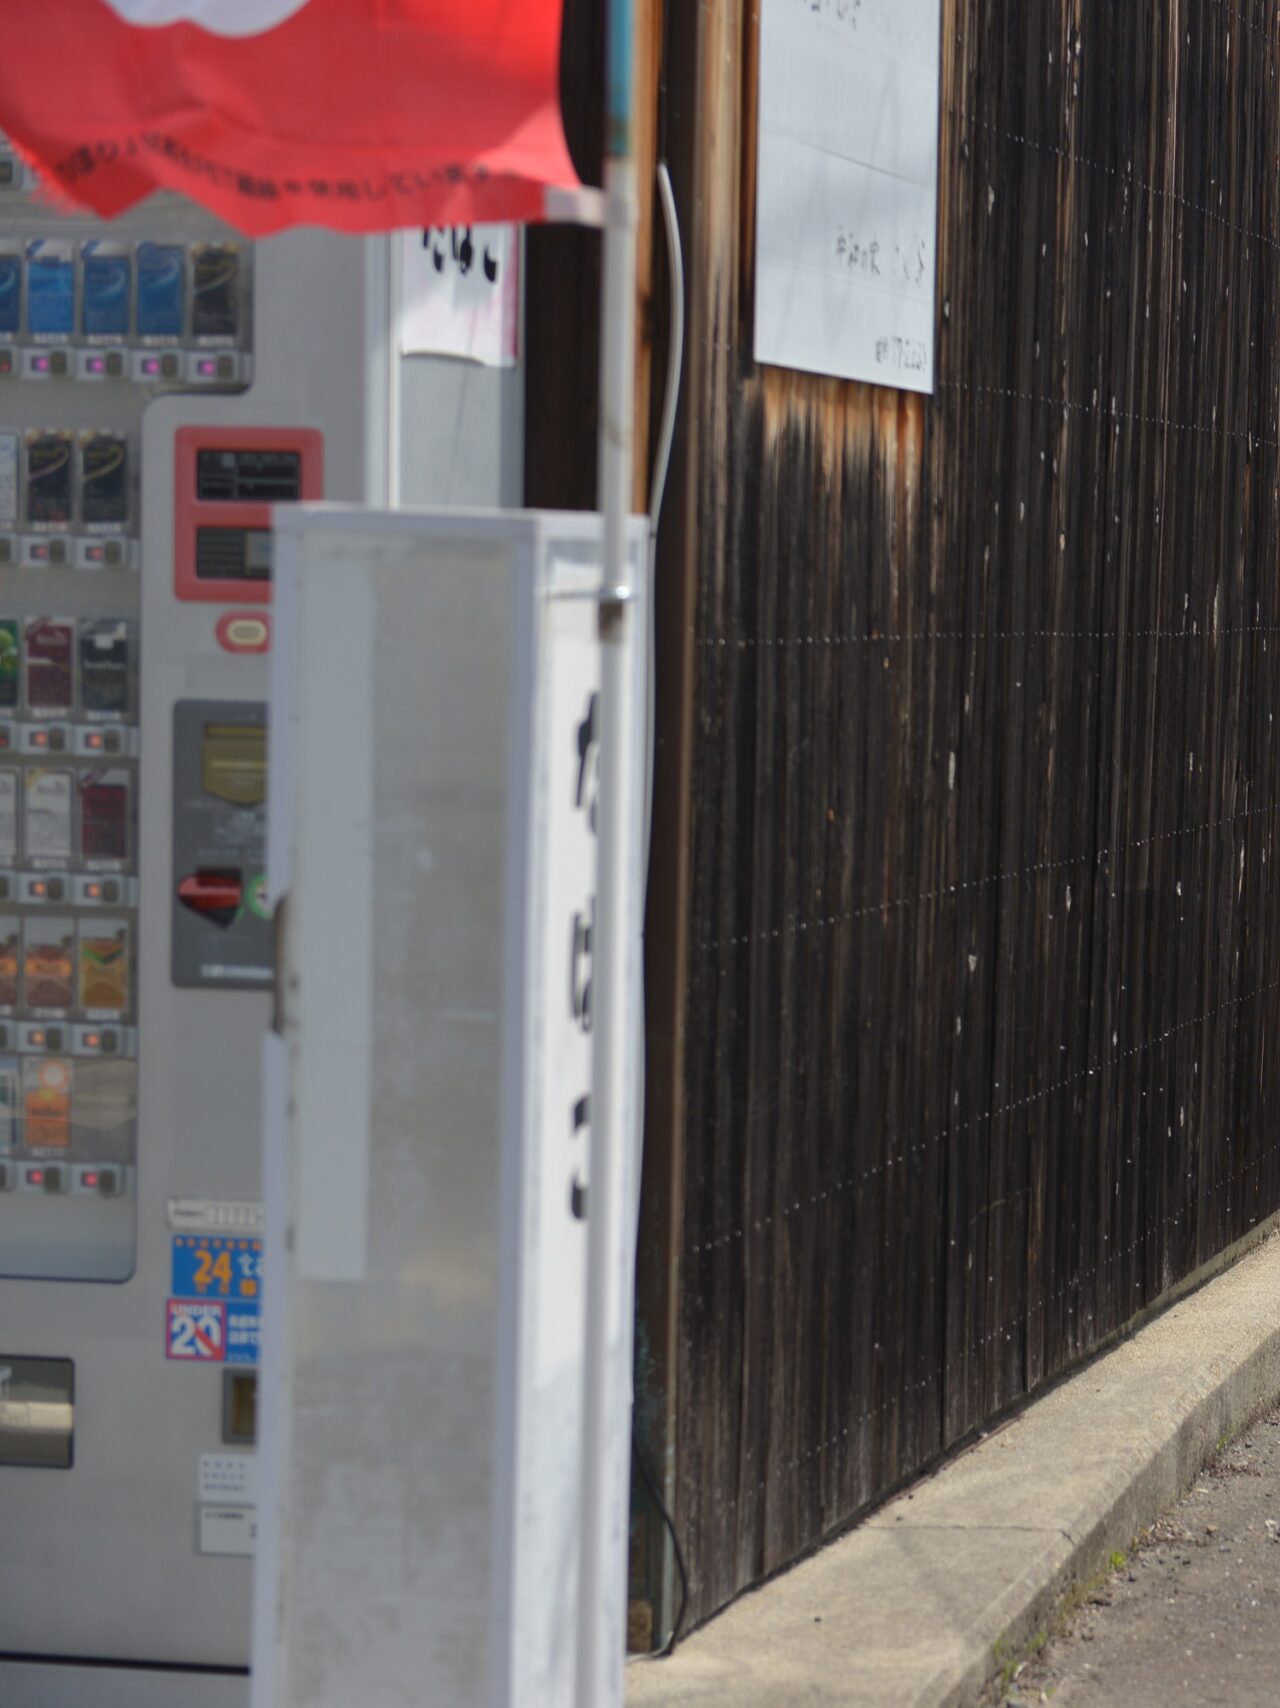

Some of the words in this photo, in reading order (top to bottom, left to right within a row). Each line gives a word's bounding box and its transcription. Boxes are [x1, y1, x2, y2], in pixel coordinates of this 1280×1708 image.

[193, 1250, 233, 1285] 24
[171, 1304, 222, 1316] UNDER
[172, 1316, 222, 1356] 20
